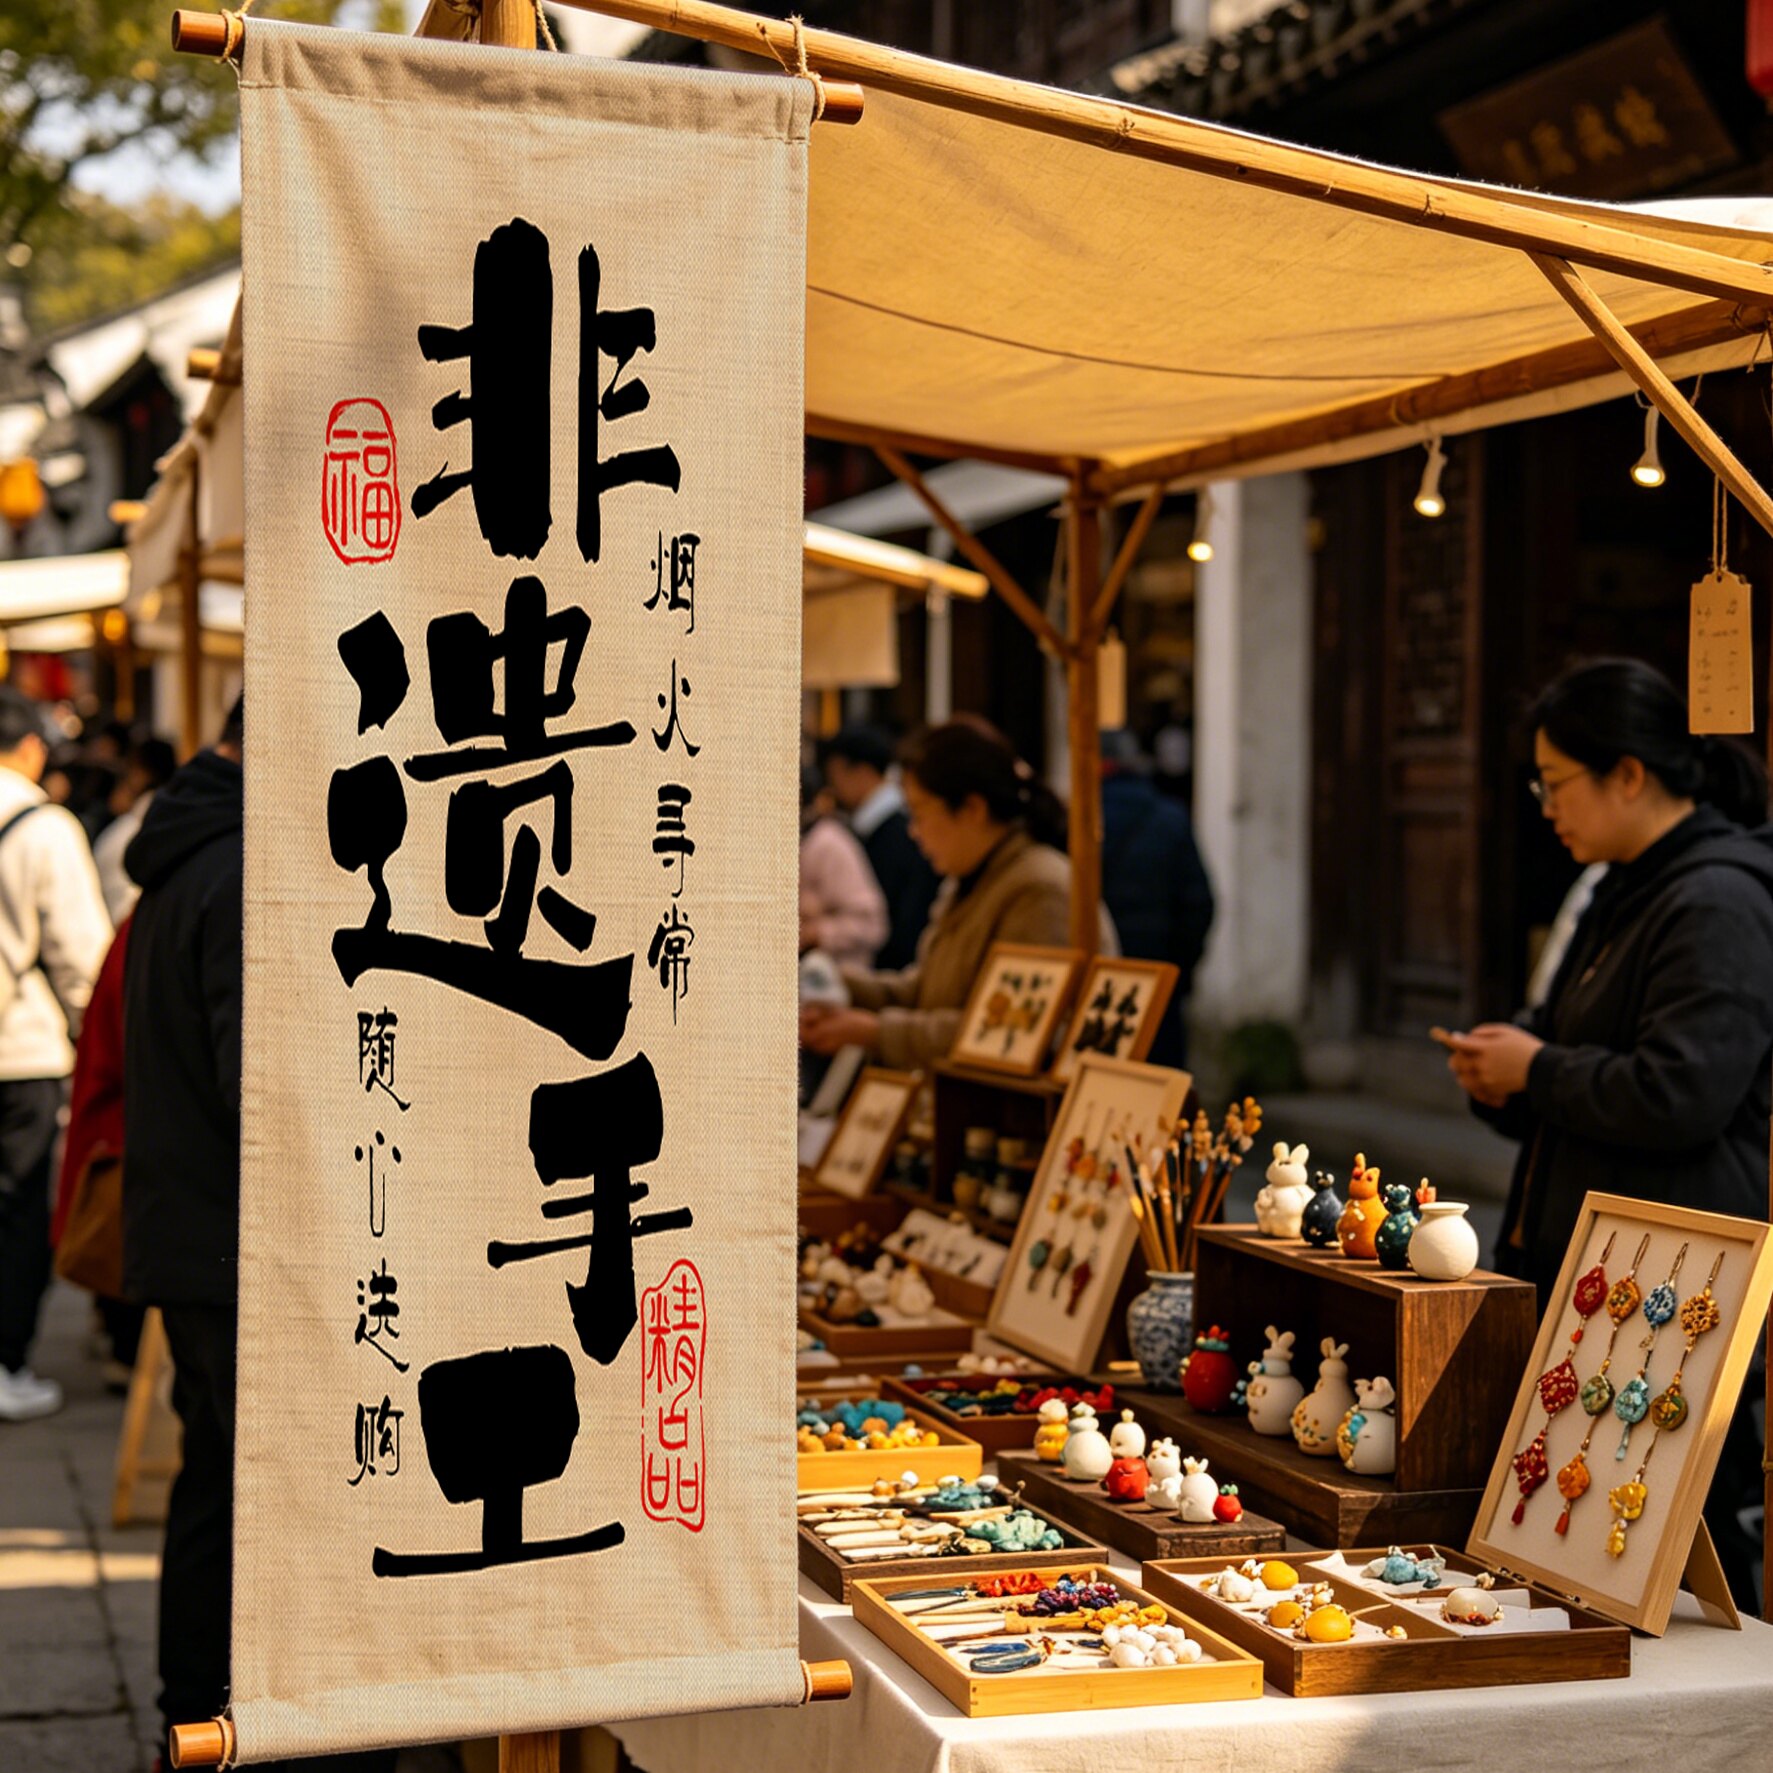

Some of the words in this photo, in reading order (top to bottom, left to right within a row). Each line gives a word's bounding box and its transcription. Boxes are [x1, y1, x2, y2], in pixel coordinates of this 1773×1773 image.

[329, 427, 395, 551] 福
[328, 218, 693, 1577] 非遗手工
[644, 530, 701, 1026] 烟火寻常
[347, 1005, 412, 1487] 随心选购
[645, 1272, 703, 1516] 精品
